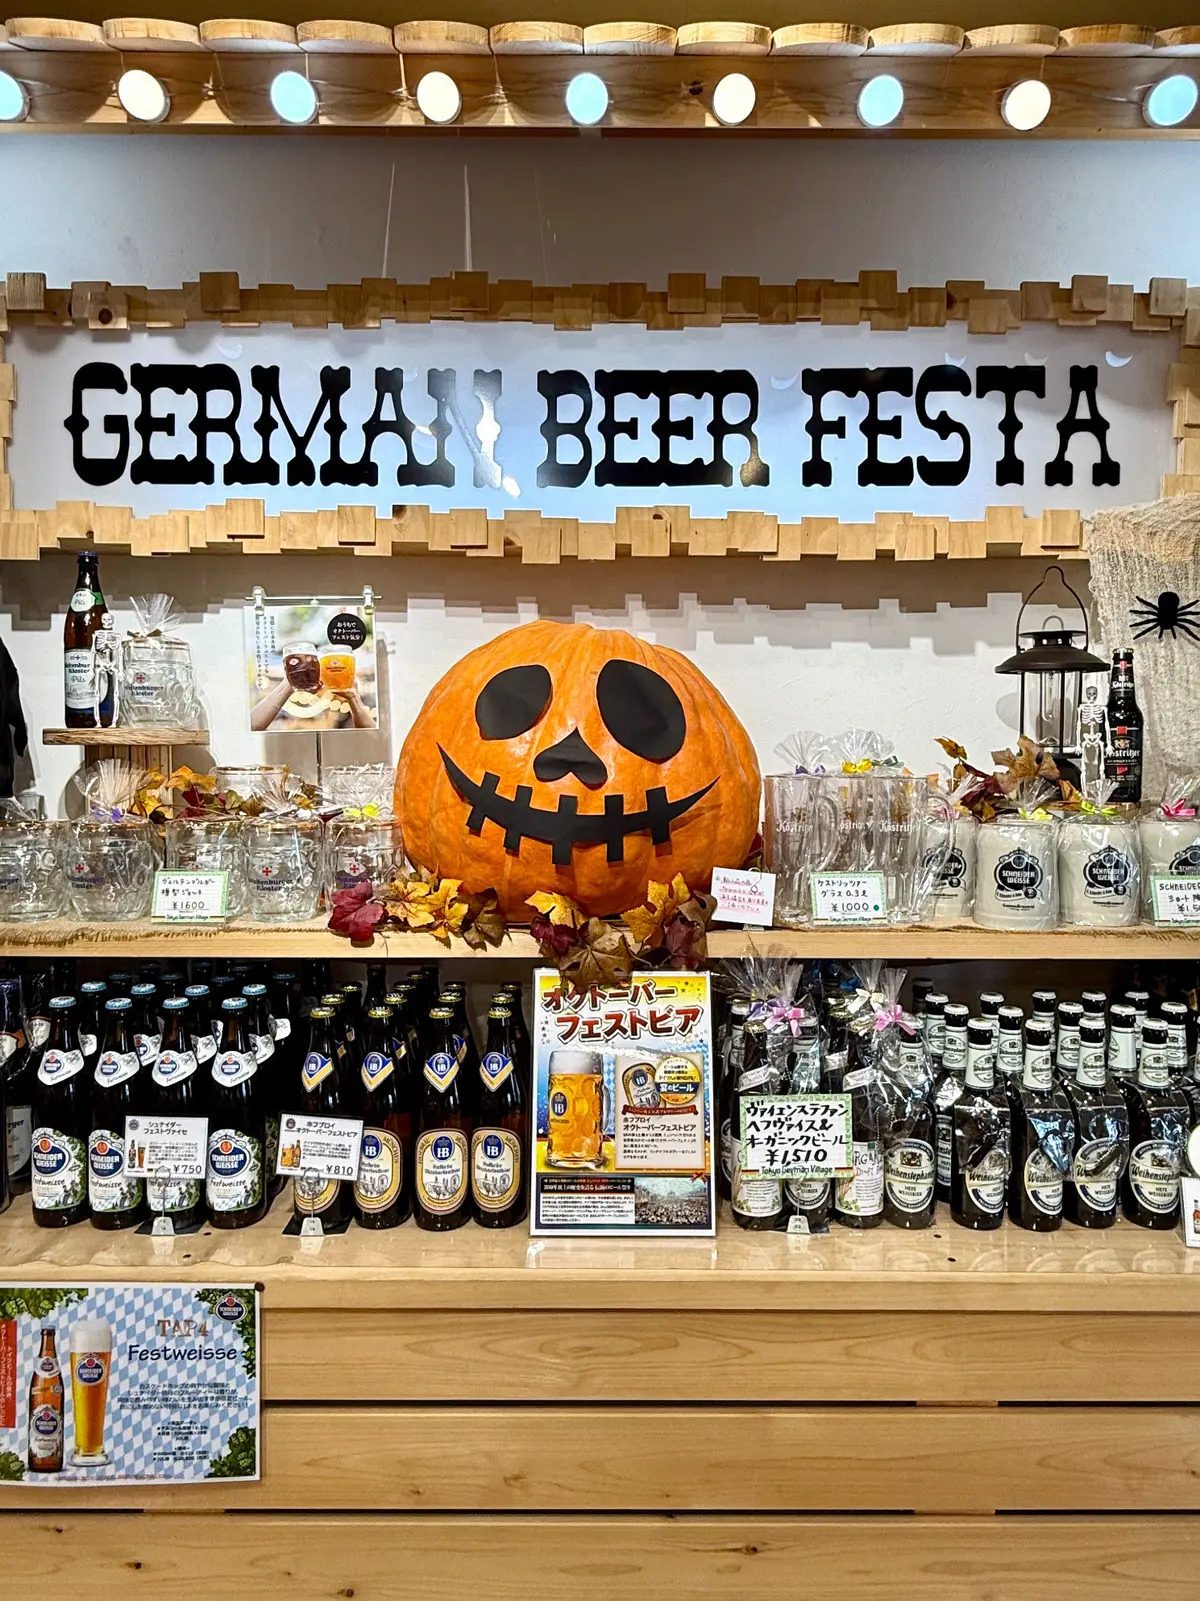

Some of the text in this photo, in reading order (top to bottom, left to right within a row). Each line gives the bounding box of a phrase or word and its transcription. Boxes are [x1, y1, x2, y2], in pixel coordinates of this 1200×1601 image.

[64, 363, 1121, 487] GERMAN BEER FESTA
[1002, 870, 1036, 878] SCHNEIDER
[821, 889, 842, 898] グラス
[172, 901, 206, 910] ¥1600
[543, 980, 677, 1011] オクトーバー
[556, 1008, 702, 1042] フェストビア
[746, 1100, 849, 1118] ヴァイエンステファン
[306, 1121, 336, 1129] ホフブロイ
[747, 1116, 834, 1132] ヘフヴァイス&
[144, 1128, 188, 1136] フェストヴァイセ
[296, 1127, 358, 1138] オクトーバーフェストビア
[746, 1131, 850, 1148] オーガニックビール
[365, 1145, 377, 1157] HB
[437, 1147, 449, 1158] HB
[486, 1145, 499, 1157] HB
[90, 1153, 120, 1162] SCHNEIDER
[211, 1153, 245, 1162] SCHNEIDER
[765, 1148, 828, 1167] ¥1,510
[36, 1160, 57, 1168] WEISSE
[173, 1164, 202, 1174] ¥750
[215, 1160, 239, 1168] WEISSE
[326, 1164, 354, 1176] ¥810
[761, 1165, 833, 1177] Tokyo German Village
[210, 1177, 247, 1188] Festweisse
[128, 1344, 238, 1361] Festweisse
